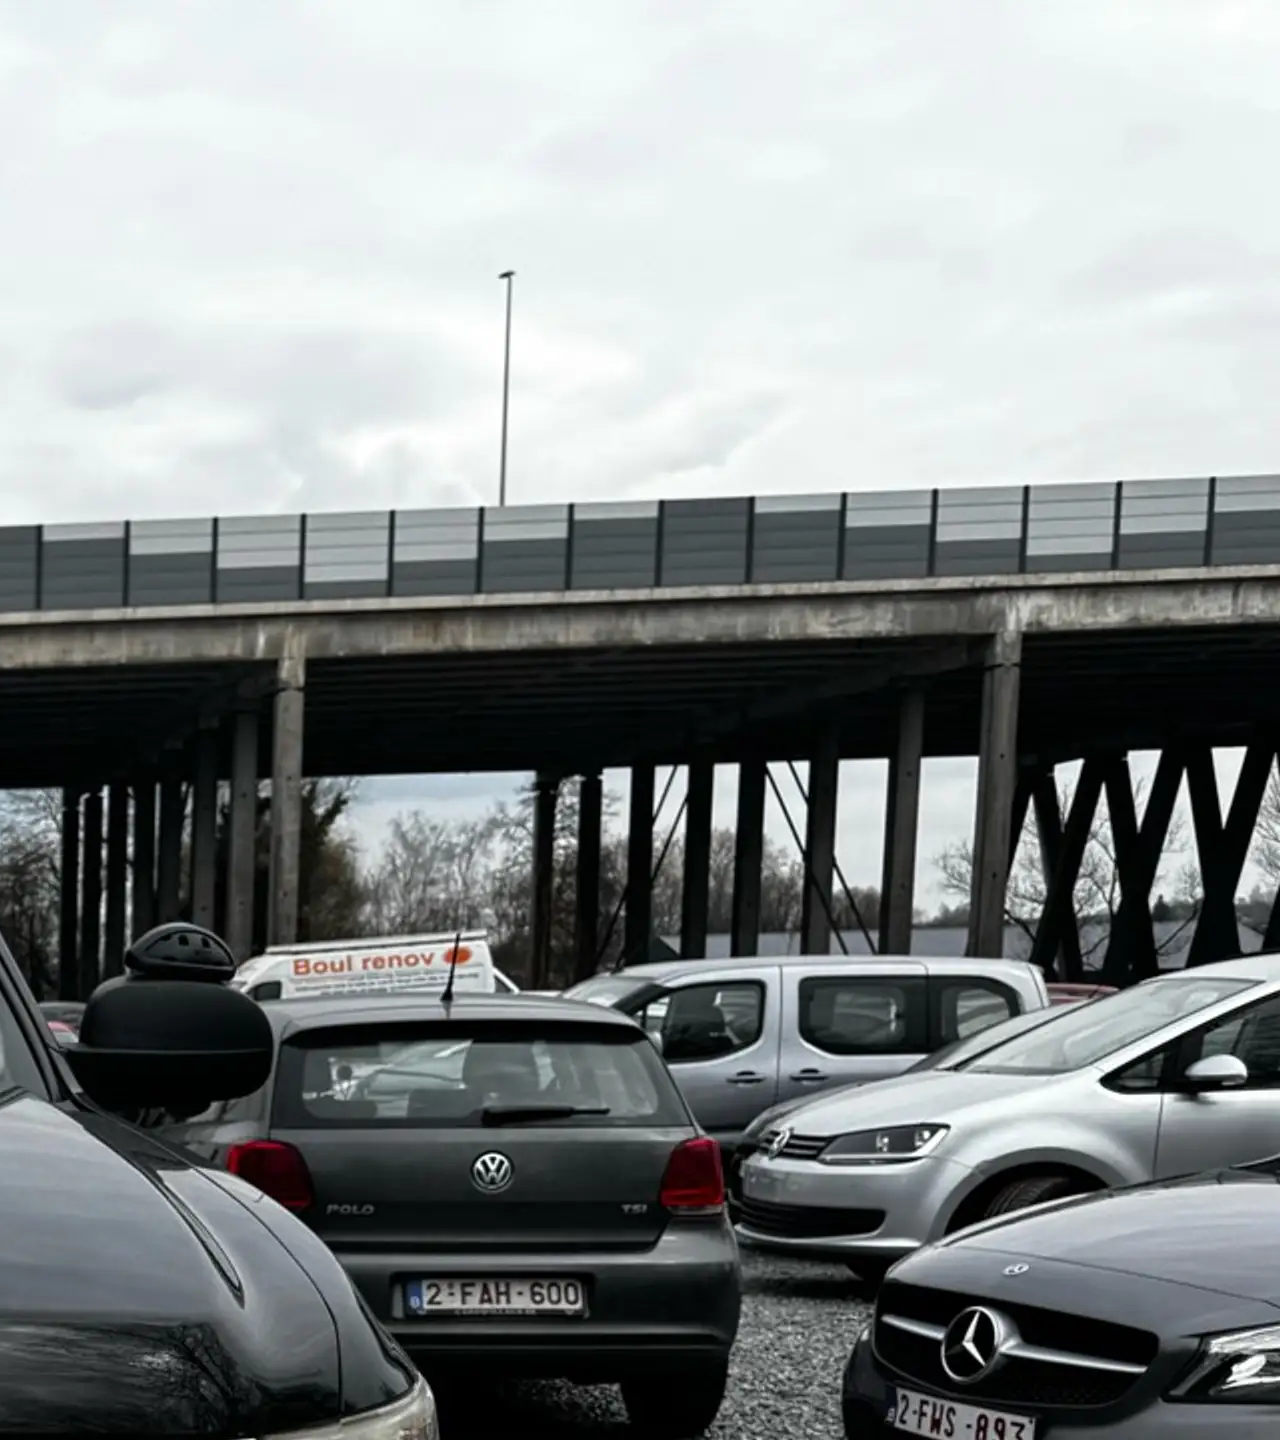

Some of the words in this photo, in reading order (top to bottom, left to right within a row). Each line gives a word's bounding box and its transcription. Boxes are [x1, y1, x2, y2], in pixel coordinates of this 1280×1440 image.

[292, 955, 352, 976] Boul
[361, 951, 436, 971] renov
[326, 1203, 375, 1215] POLO
[621, 1203, 648, 1215] TSI
[426, 1281, 580, 1306] 2-FAH-600
